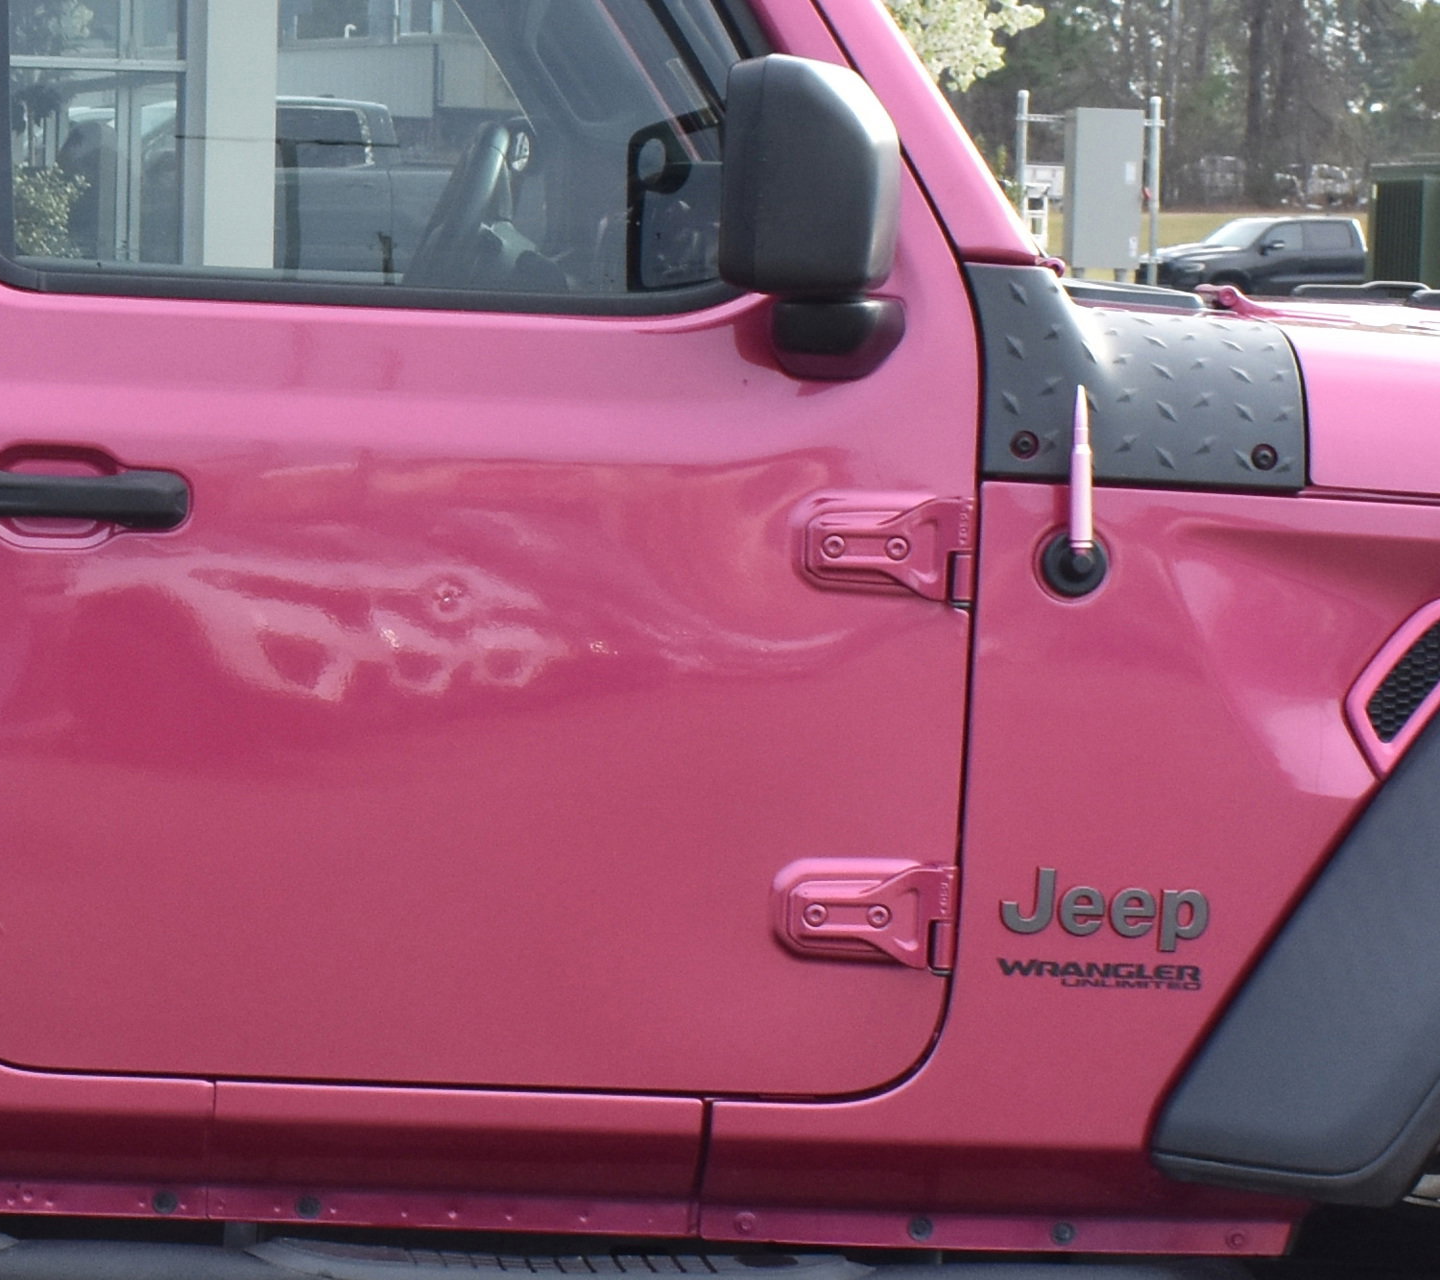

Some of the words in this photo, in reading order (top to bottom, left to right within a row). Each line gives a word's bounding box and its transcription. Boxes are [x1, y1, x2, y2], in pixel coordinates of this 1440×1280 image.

[999, 867, 1209, 952] Jeep
[996, 957, 1201, 981] WRANGLER
[1060, 978, 1202, 991] UNLIMITED
